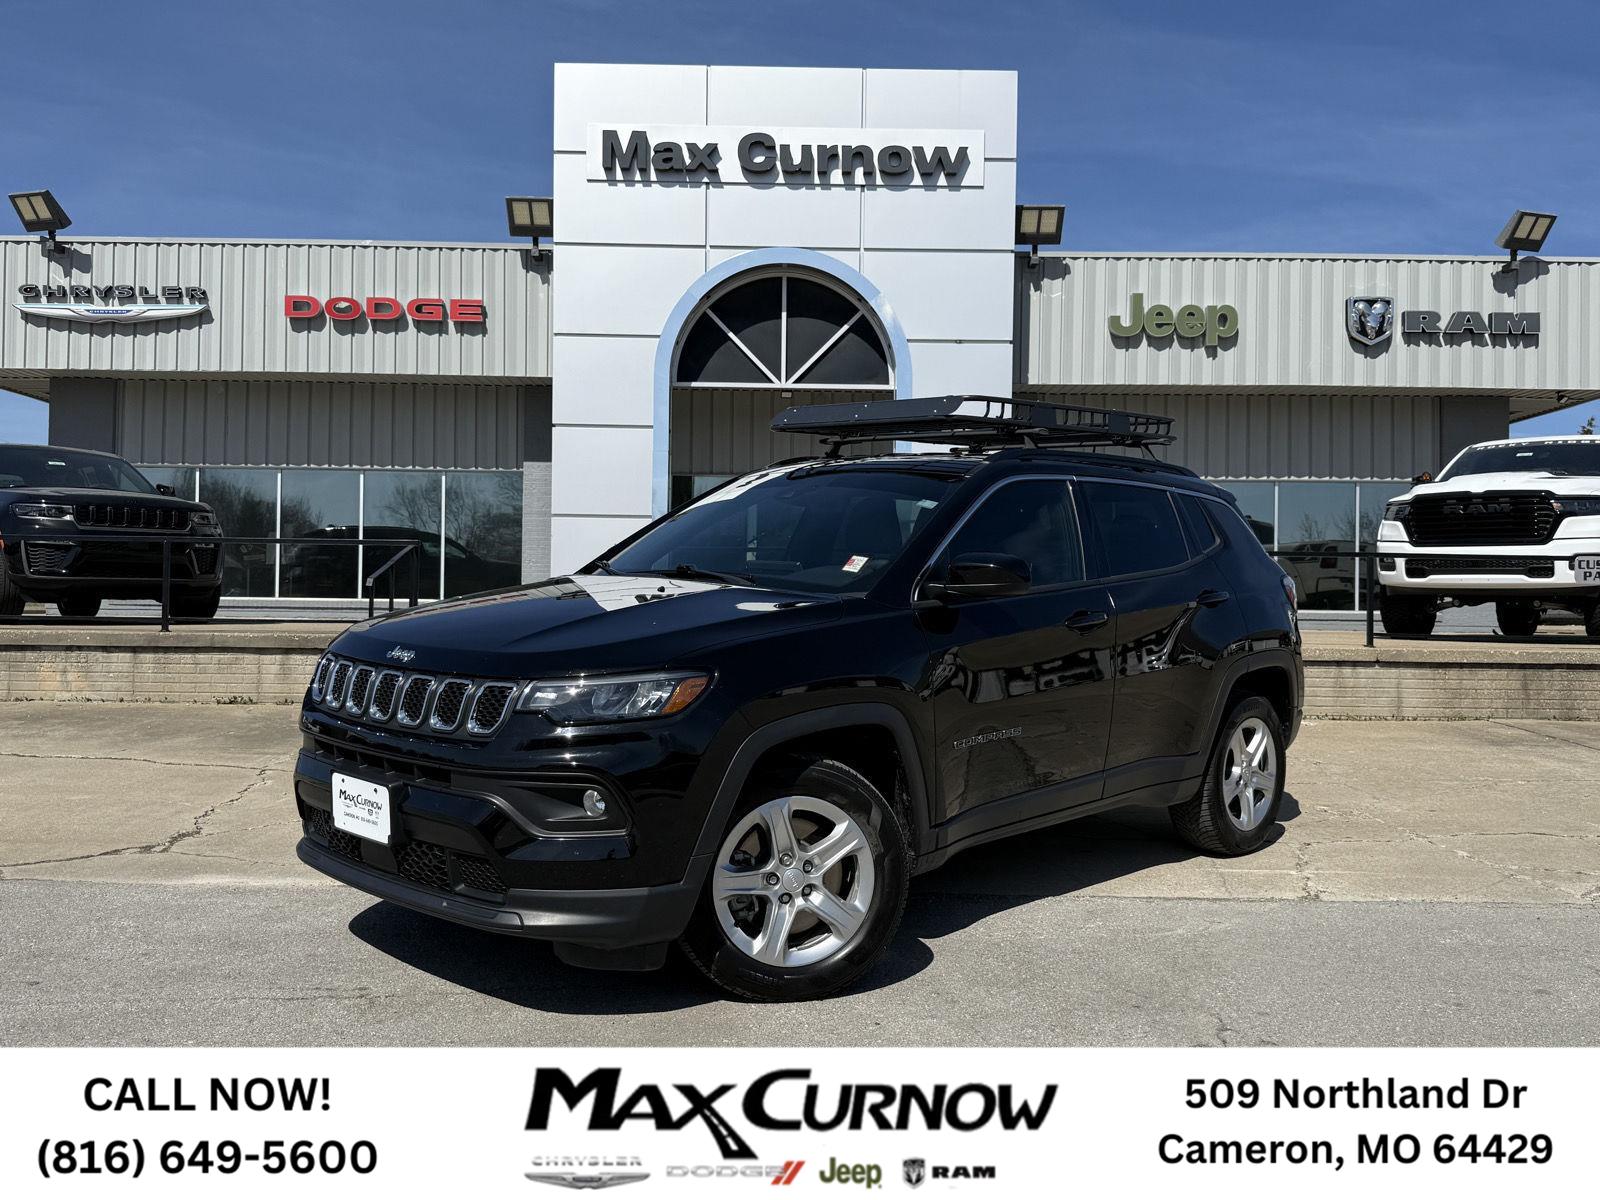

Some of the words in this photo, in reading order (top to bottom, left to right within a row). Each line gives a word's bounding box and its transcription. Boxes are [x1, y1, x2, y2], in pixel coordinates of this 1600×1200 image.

[602, 129, 719, 175] Max
[737, 132, 970, 177] Curnow
[18, 283, 206, 299] CHRYSLER
[284, 294, 484, 322] DODGE
[1108, 292, 1239, 346] Jeep
[1402, 310, 1541, 335] RAM
